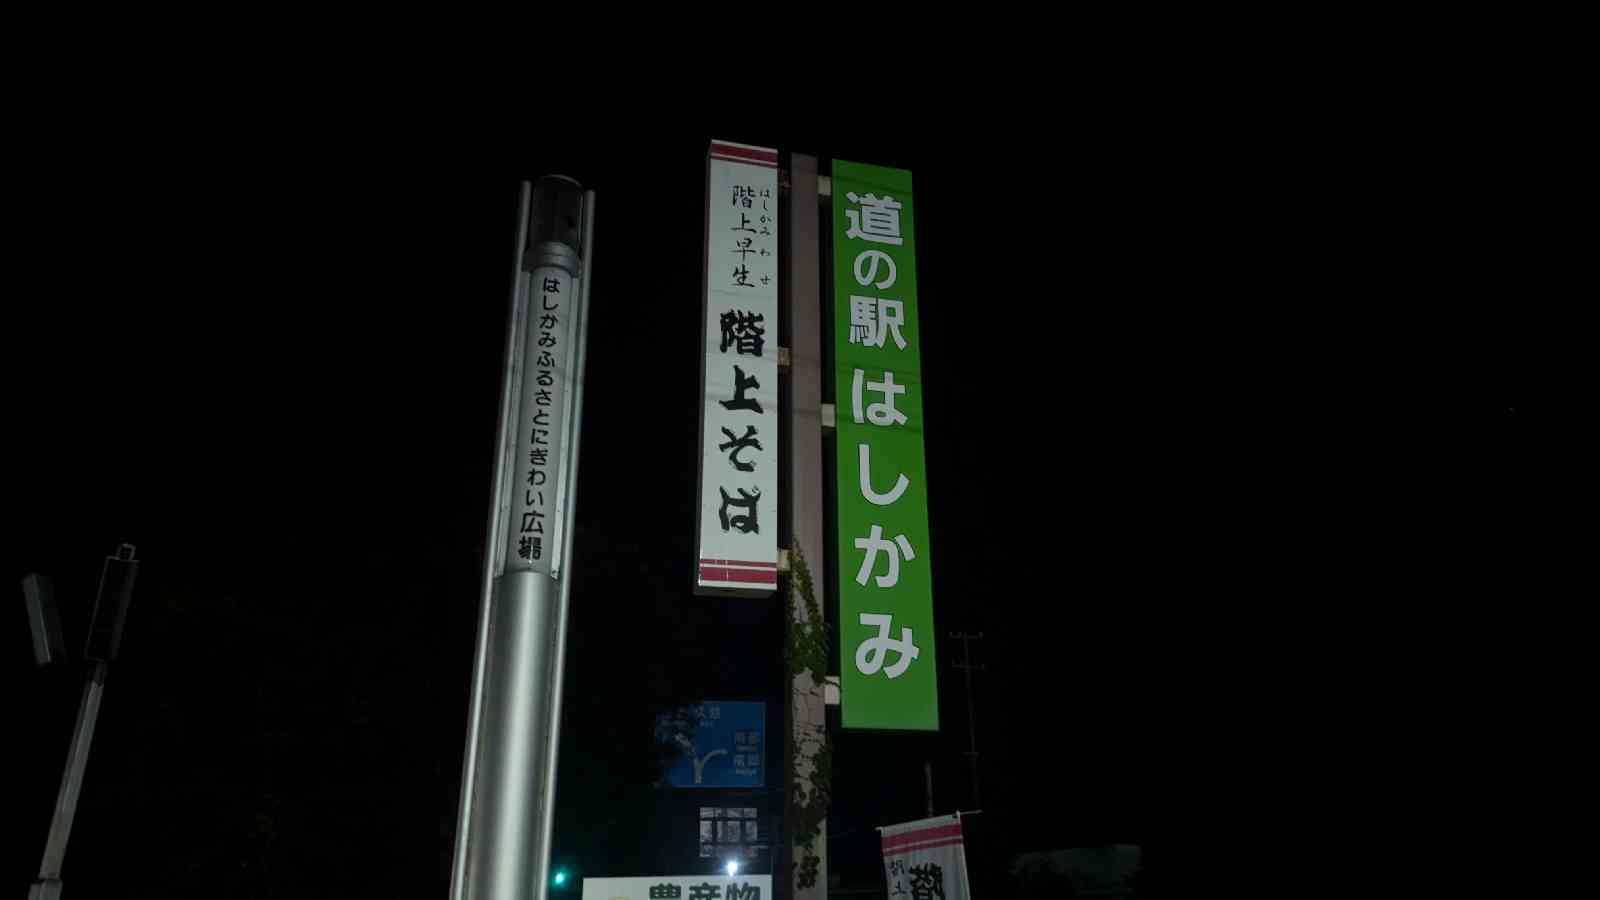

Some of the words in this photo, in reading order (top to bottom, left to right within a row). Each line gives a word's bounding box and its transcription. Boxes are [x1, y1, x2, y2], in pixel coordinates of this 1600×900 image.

[728, 185, 757, 288] 階上早生
[518, 277, 561, 561] はしかみふるさとにぎわい広場
[718, 309, 766, 534] 階上そば
